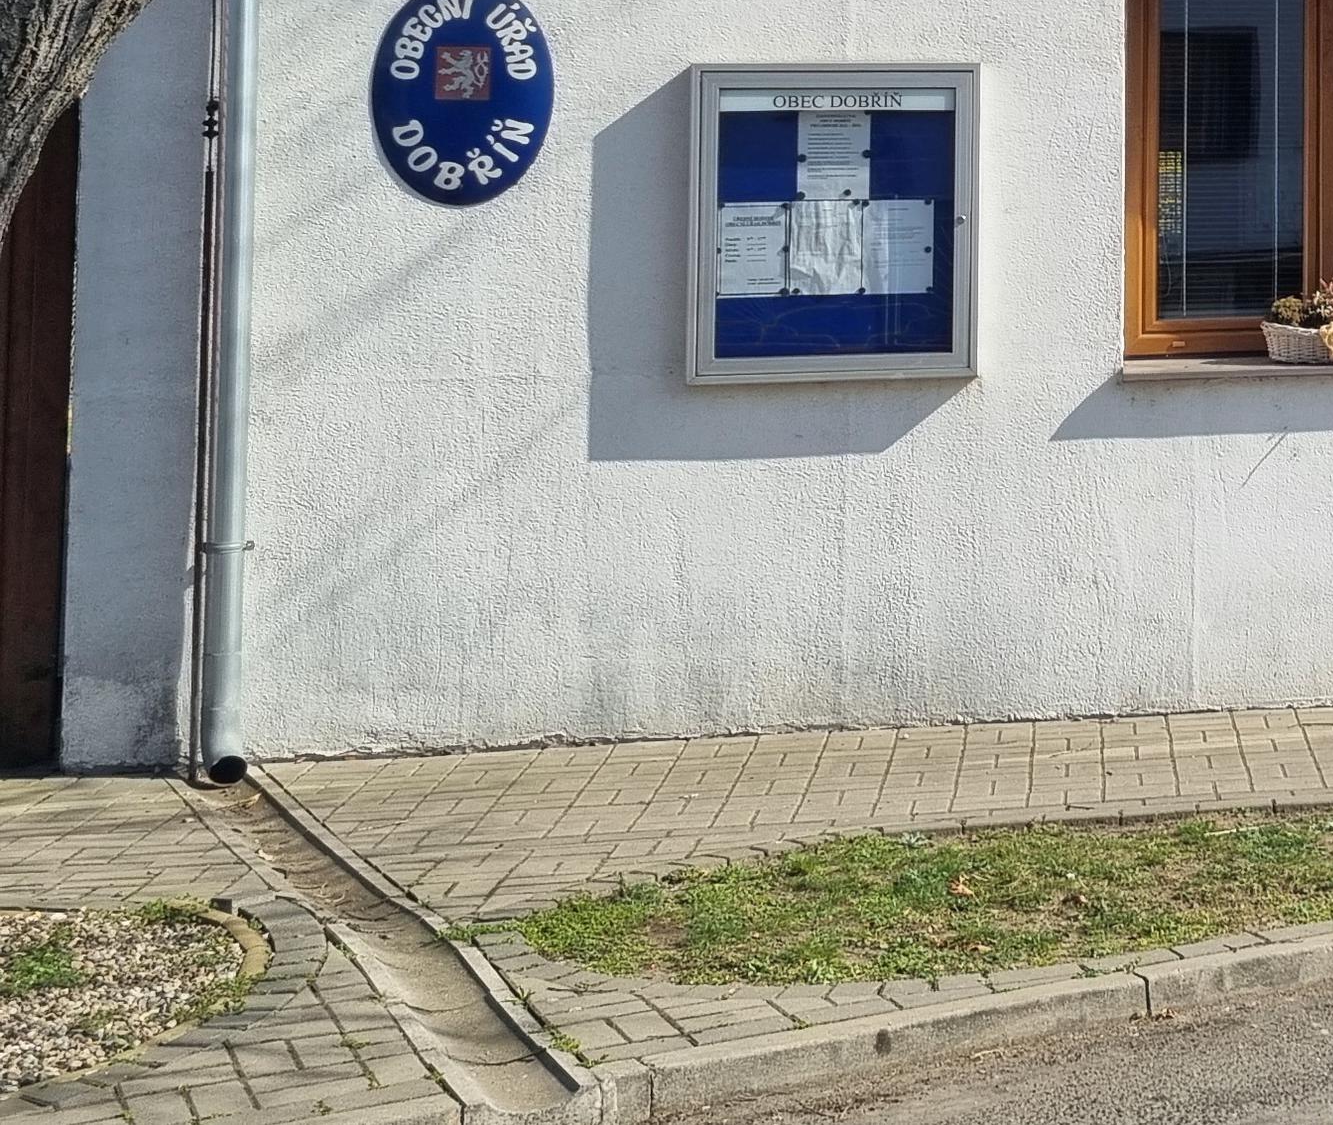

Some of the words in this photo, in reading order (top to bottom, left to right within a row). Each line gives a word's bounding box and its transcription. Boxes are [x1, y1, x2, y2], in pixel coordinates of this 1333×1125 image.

[485, 2, 537, 80] ÚŘAD
[773, 94, 825, 109] OBEC
[830, 91, 903, 108] DOBŘÍŇ
[392, 118, 535, 191] DOBŘÍŇ
